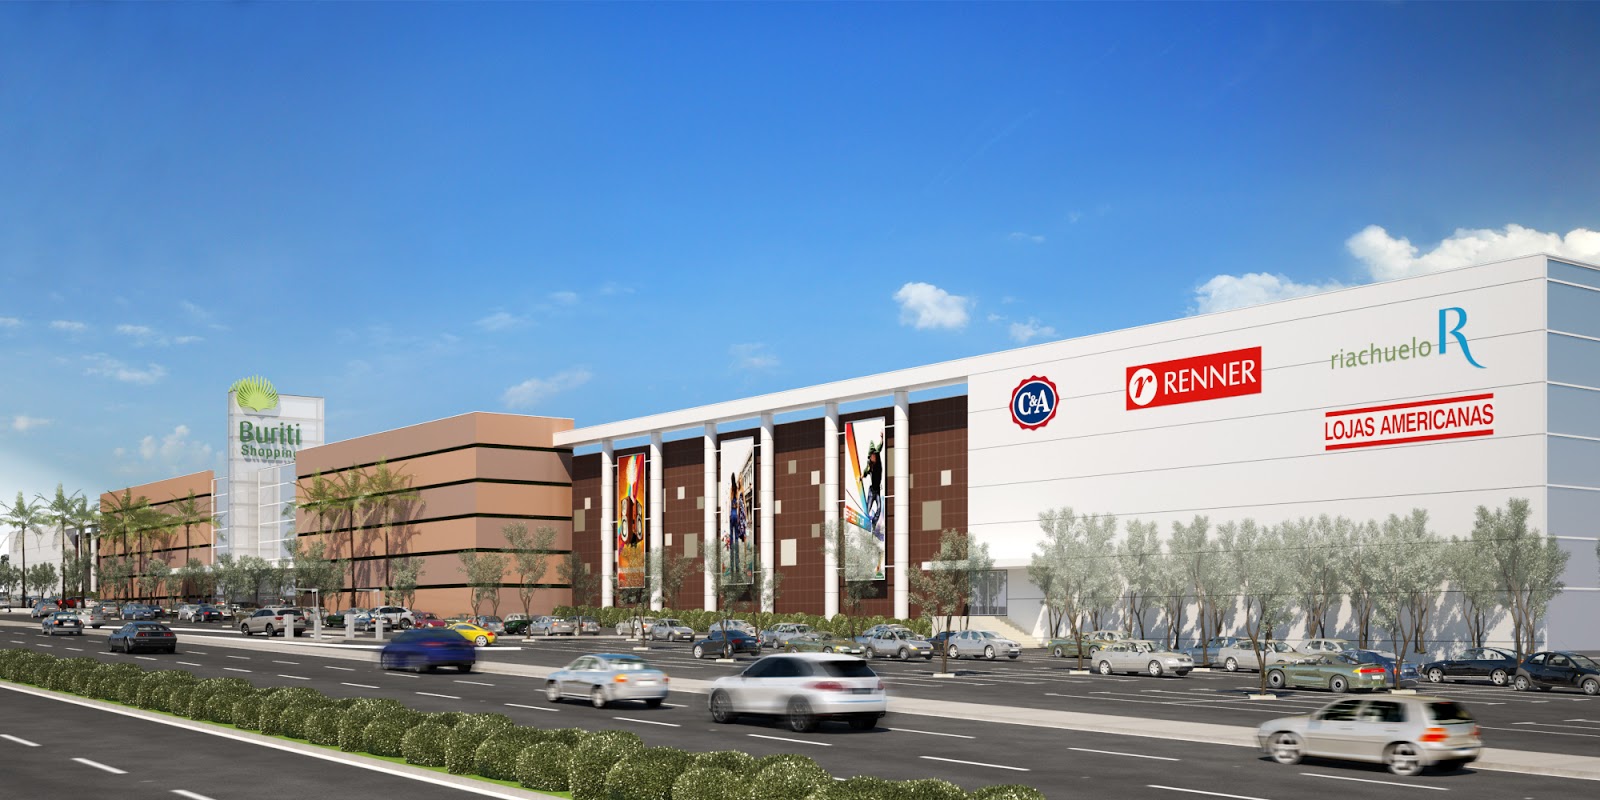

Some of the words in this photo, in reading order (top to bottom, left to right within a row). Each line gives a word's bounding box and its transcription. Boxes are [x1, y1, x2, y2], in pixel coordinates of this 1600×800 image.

[1331, 336, 1432, 370] riachuelo
[1438, 306, 1487, 369] R
[1163, 359, 1256, 395] RENNER
[1018, 389, 1051, 416] C&A
[239, 421, 300, 445] Buriti
[1325, 416, 1375, 441] LOJAS
[1380, 403, 1494, 435] AMERICANAS
